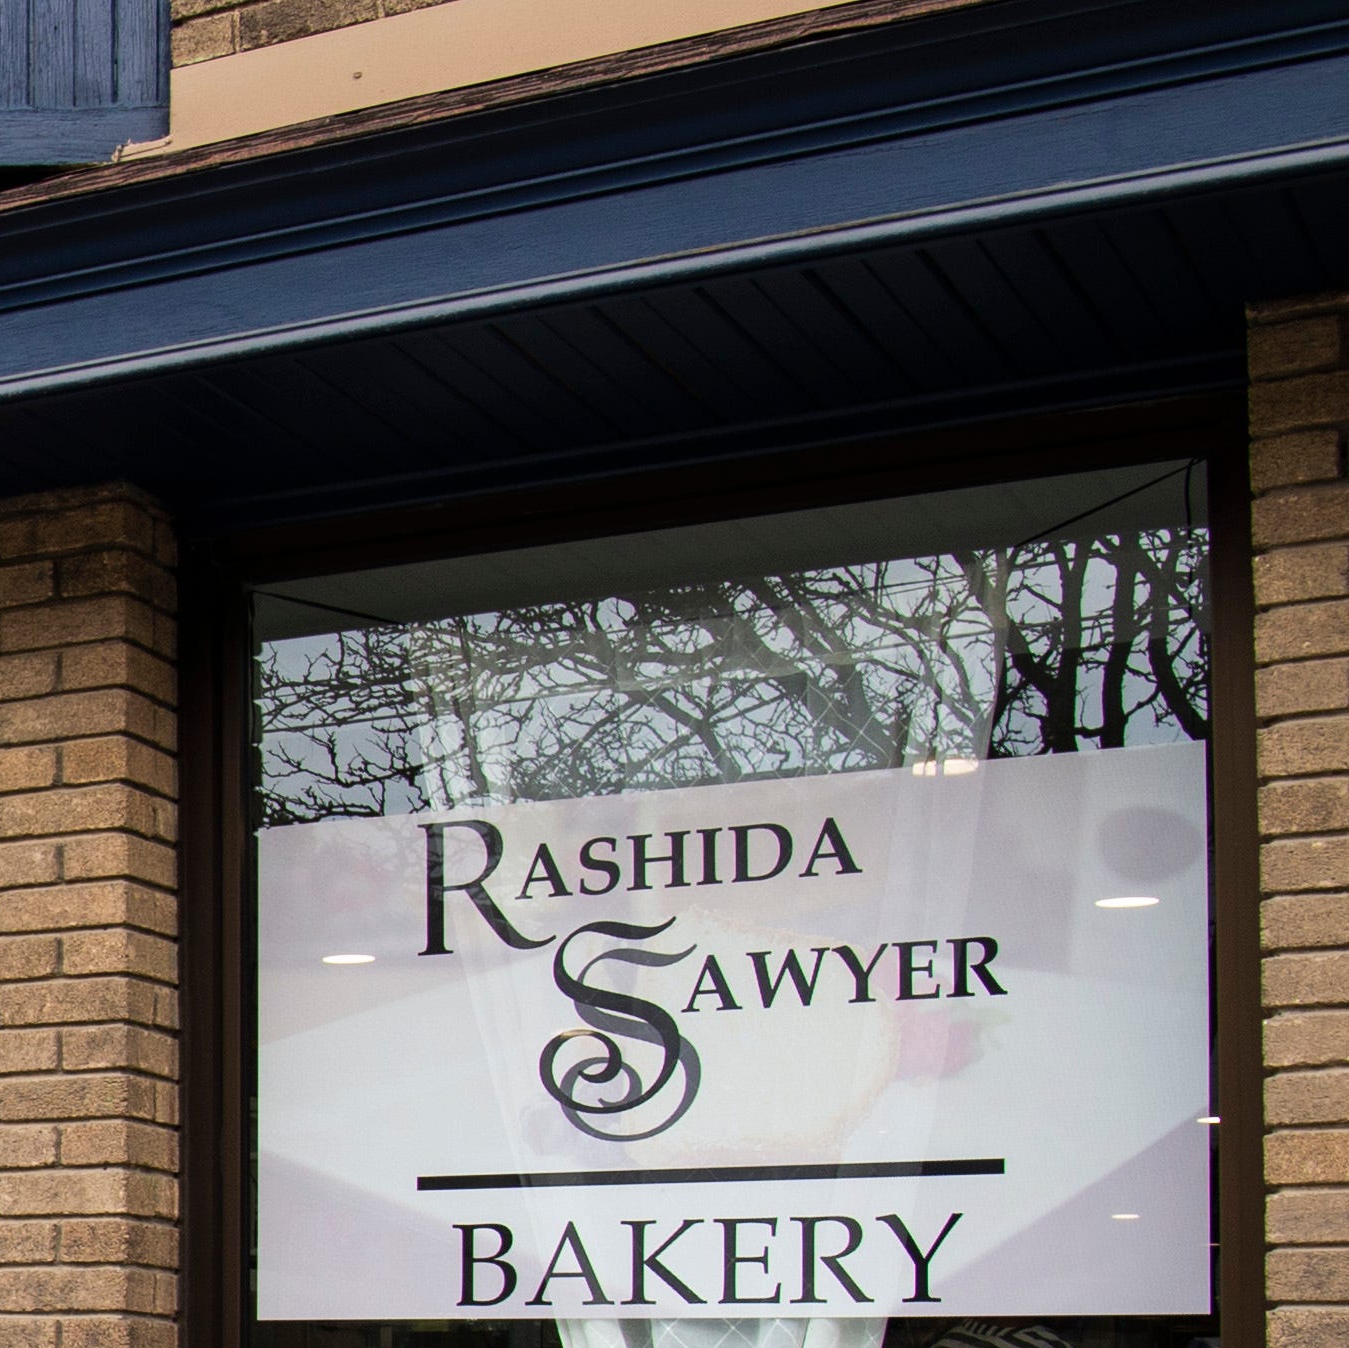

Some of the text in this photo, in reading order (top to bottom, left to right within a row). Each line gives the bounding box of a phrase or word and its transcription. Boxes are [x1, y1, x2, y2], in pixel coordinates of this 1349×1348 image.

[417, 817, 861, 957] RASHIDA
[539, 916, 1007, 1142] SAWYER
[453, 1212, 964, 1308] BAKERY
